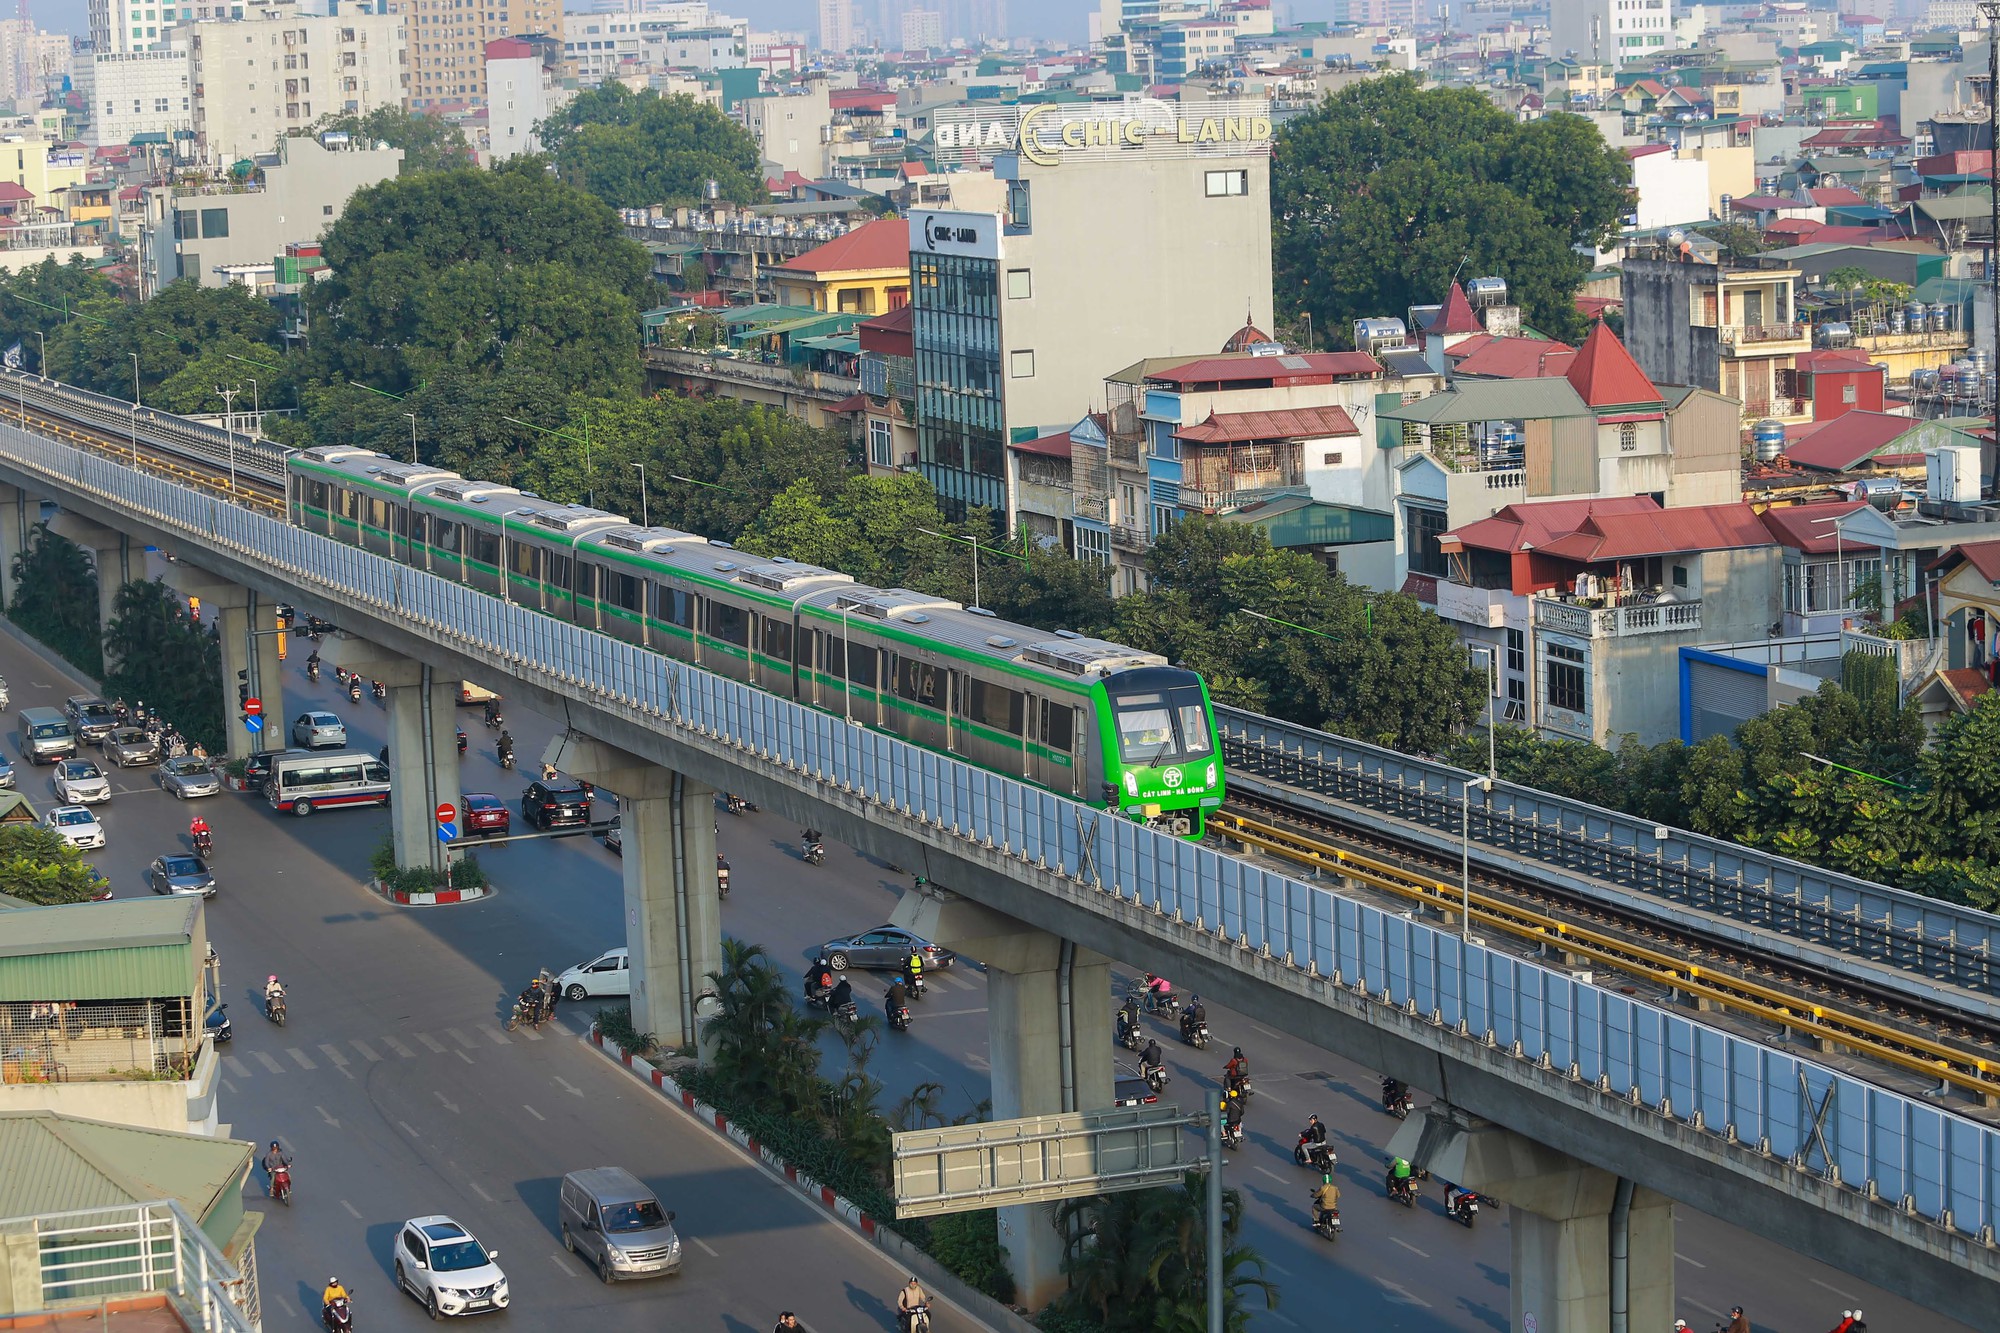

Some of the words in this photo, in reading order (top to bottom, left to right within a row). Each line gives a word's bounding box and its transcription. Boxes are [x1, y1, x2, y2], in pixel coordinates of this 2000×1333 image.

[1062, 119, 1143, 147] CHIC
[1177, 117, 1273, 143] LAND
[934, 226, 951, 241] CHIC
[956, 228, 977, 243] LAND
[1157, 789, 1171, 797] LINH
